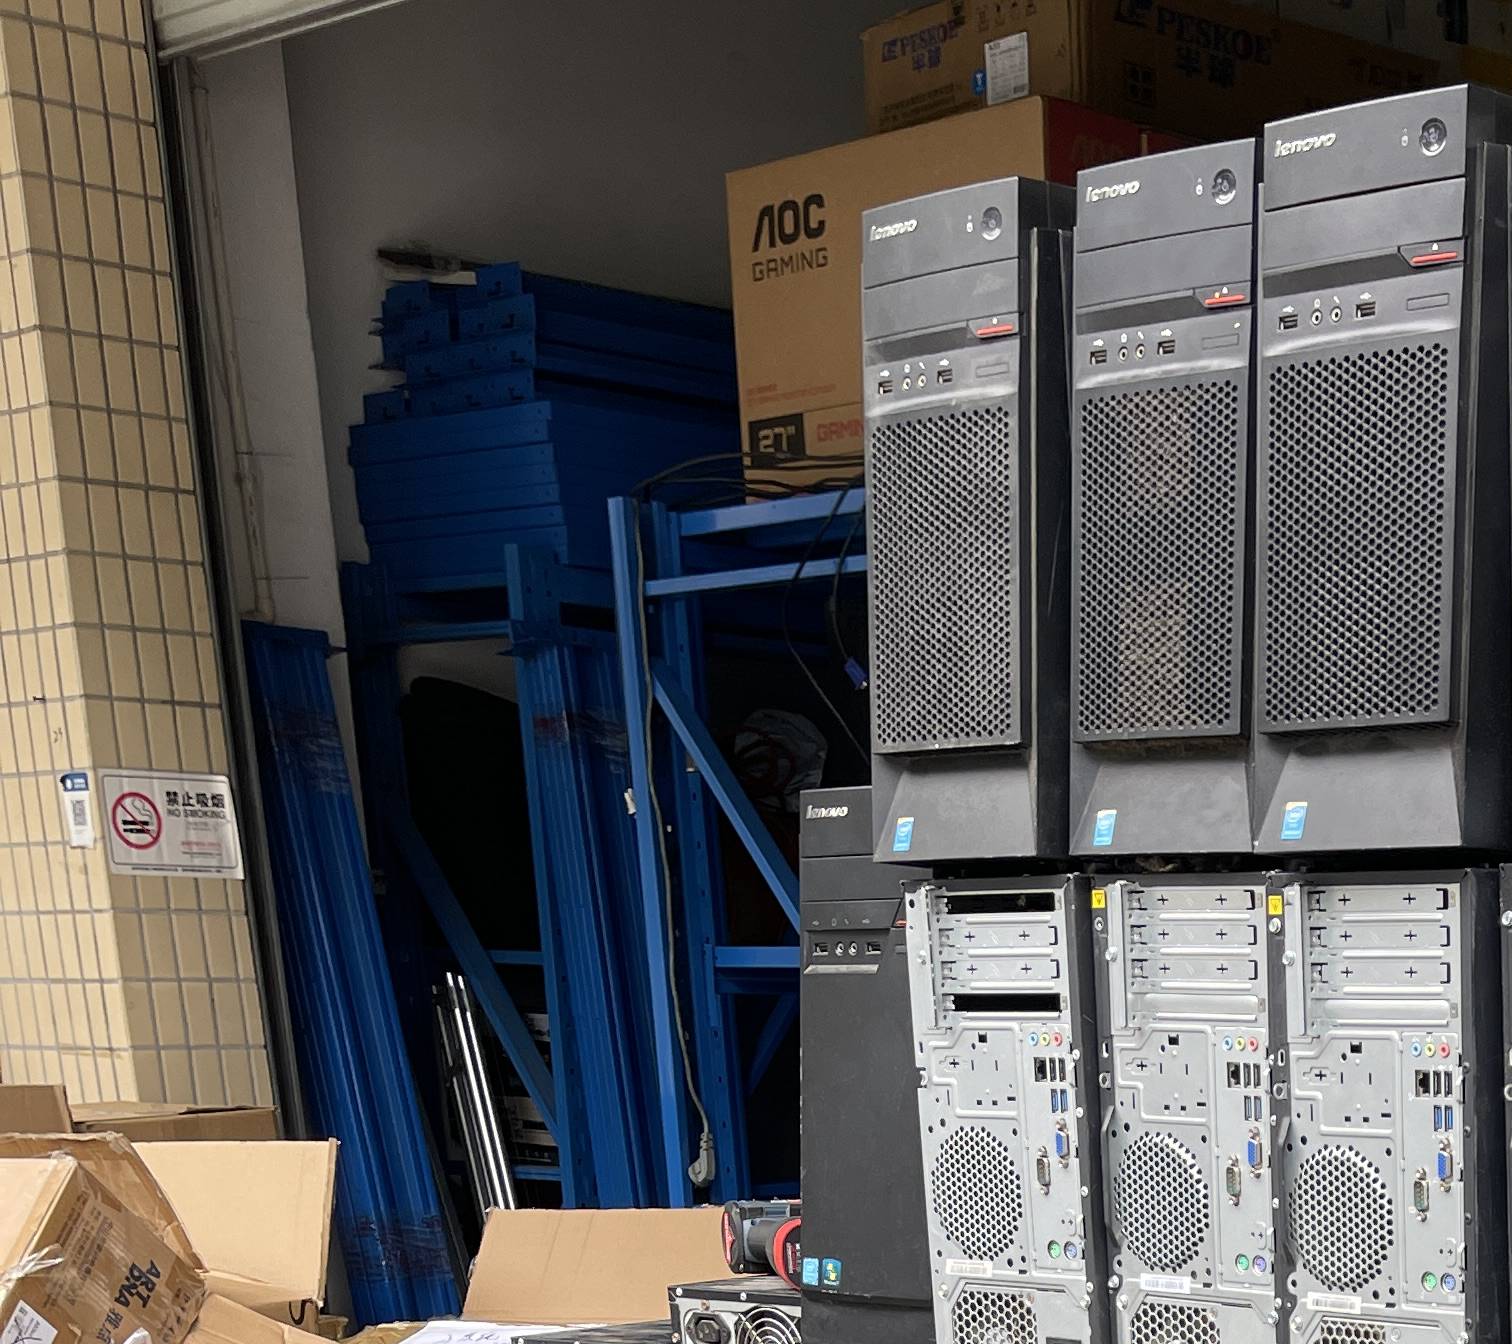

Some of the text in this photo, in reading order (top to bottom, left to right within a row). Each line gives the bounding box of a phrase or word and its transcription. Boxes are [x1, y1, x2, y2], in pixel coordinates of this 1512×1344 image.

[1274, 134, 1336, 157] lenovo
[1086, 181, 1140, 203] lenovo
[752, 194, 826, 252] AOC
[871, 220, 918, 242] lenovo
[751, 247, 828, 282] GAMING
[166, 791, 225, 808] 禁止吸烟
[167, 808, 226, 819] NO SMOKING
[806, 805, 849, 819] lenovo
[114, 1262, 145, 1308] DNA
[133, 1259, 161, 1309] ART
